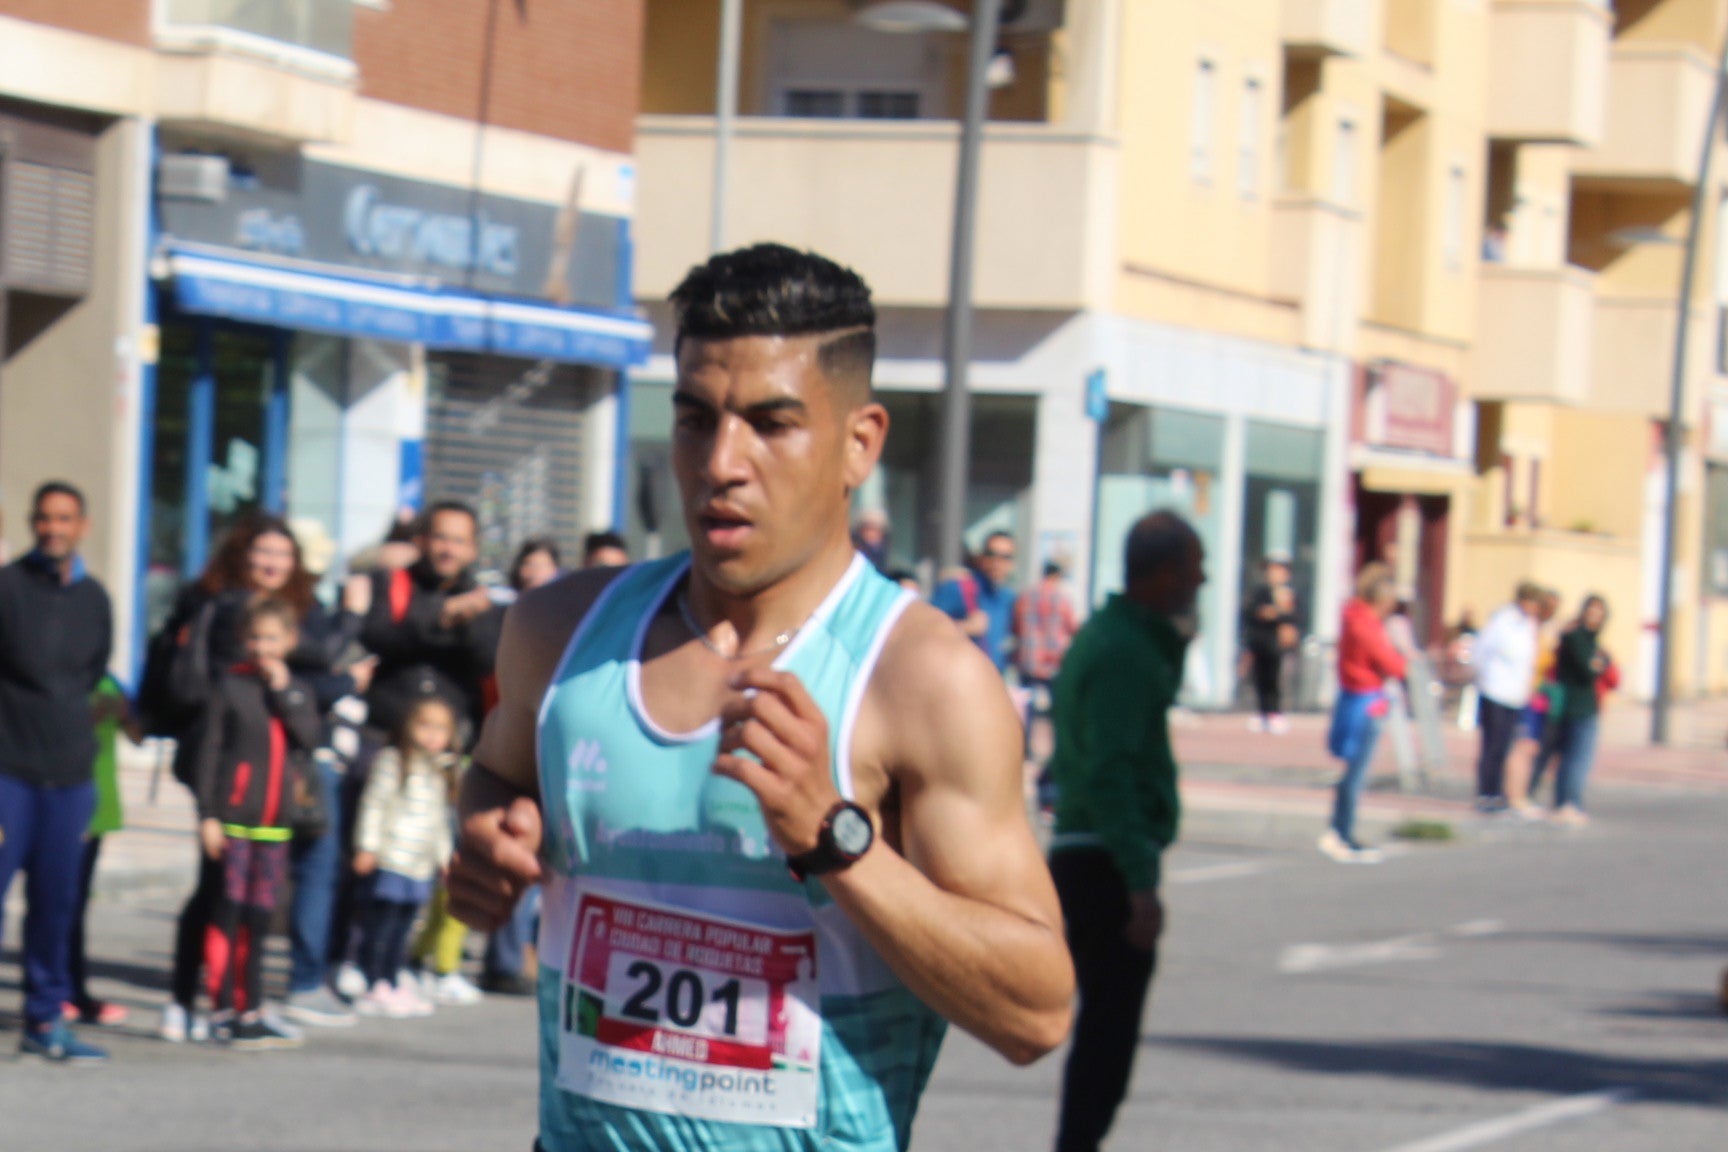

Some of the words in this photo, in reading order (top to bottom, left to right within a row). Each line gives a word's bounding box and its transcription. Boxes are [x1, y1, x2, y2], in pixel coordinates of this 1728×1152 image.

[610, 927, 660, 956] CIUDAD
[664, 938, 682, 959] DE
[637, 911, 702, 941] CARRERA
[705, 924, 773, 955] POPULAR
[621, 959, 741, 1036] 201
[589, 1048, 776, 1094] meetingpoint
